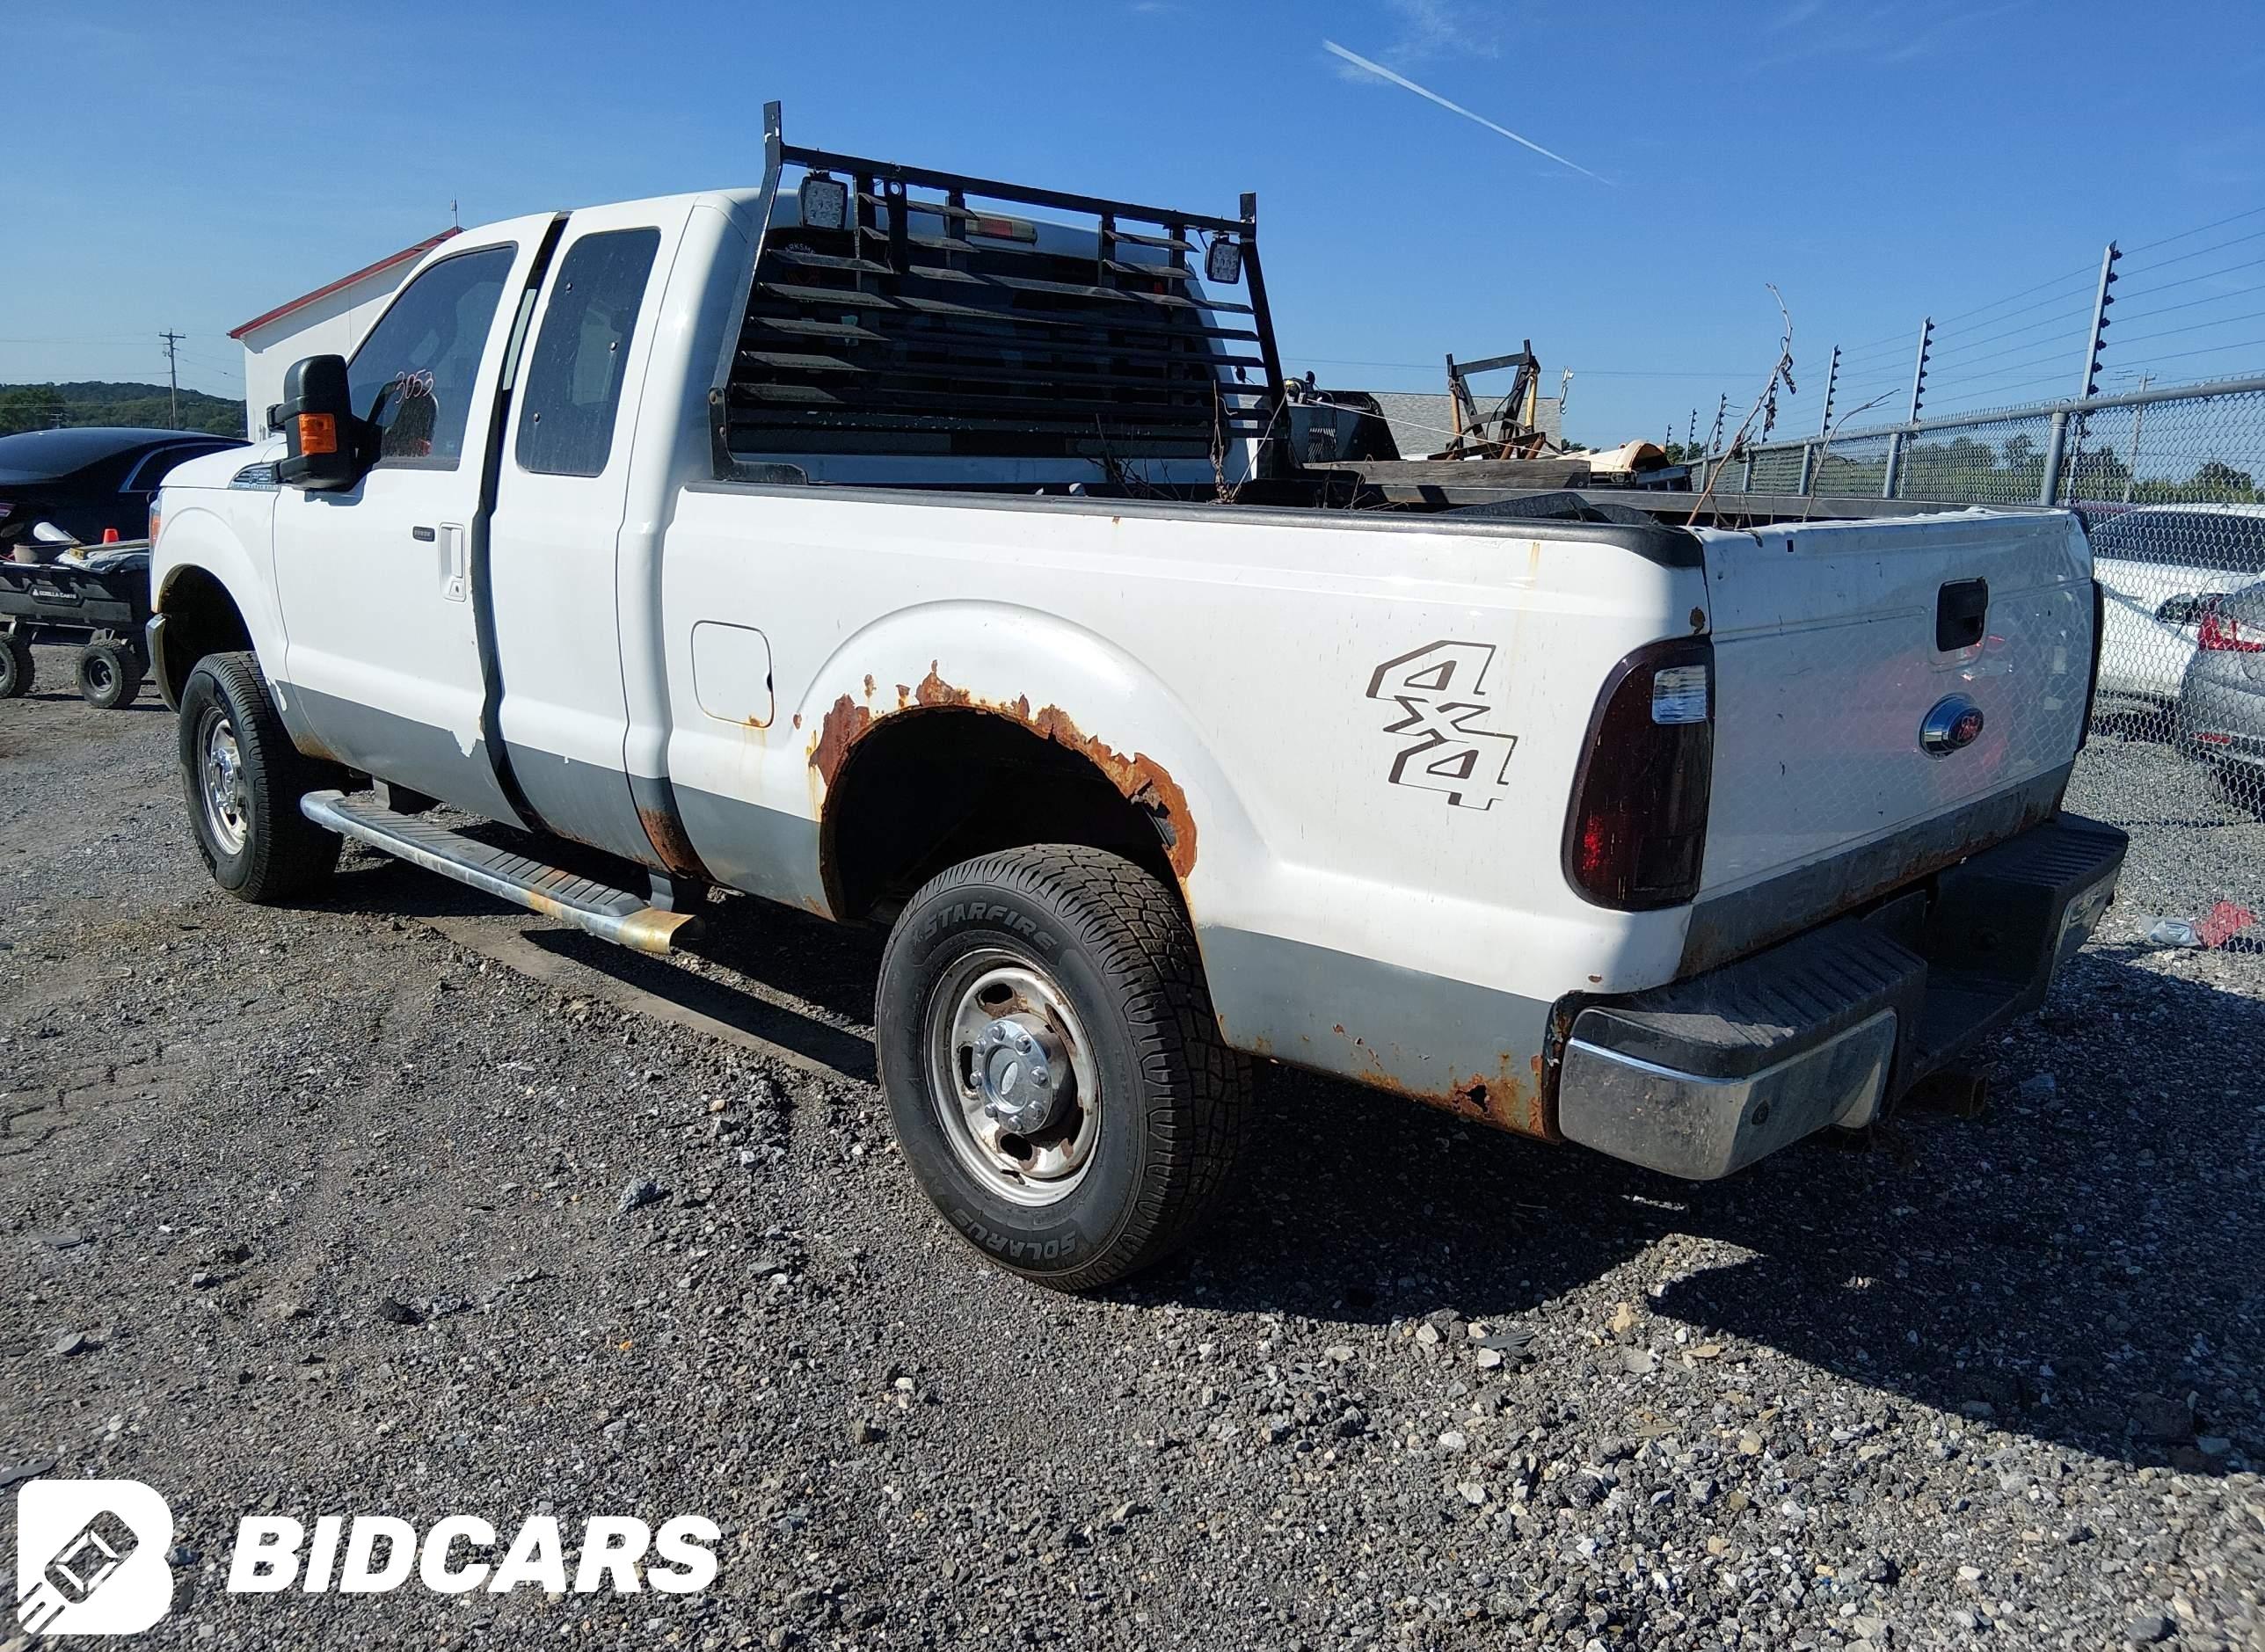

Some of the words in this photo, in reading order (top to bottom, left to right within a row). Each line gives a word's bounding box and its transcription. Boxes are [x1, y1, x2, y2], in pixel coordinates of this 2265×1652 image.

[395, 368, 433, 404] 3053
[924, 902, 1057, 950] STARFIRE
[950, 1208, 1076, 1260] SOLARUS
